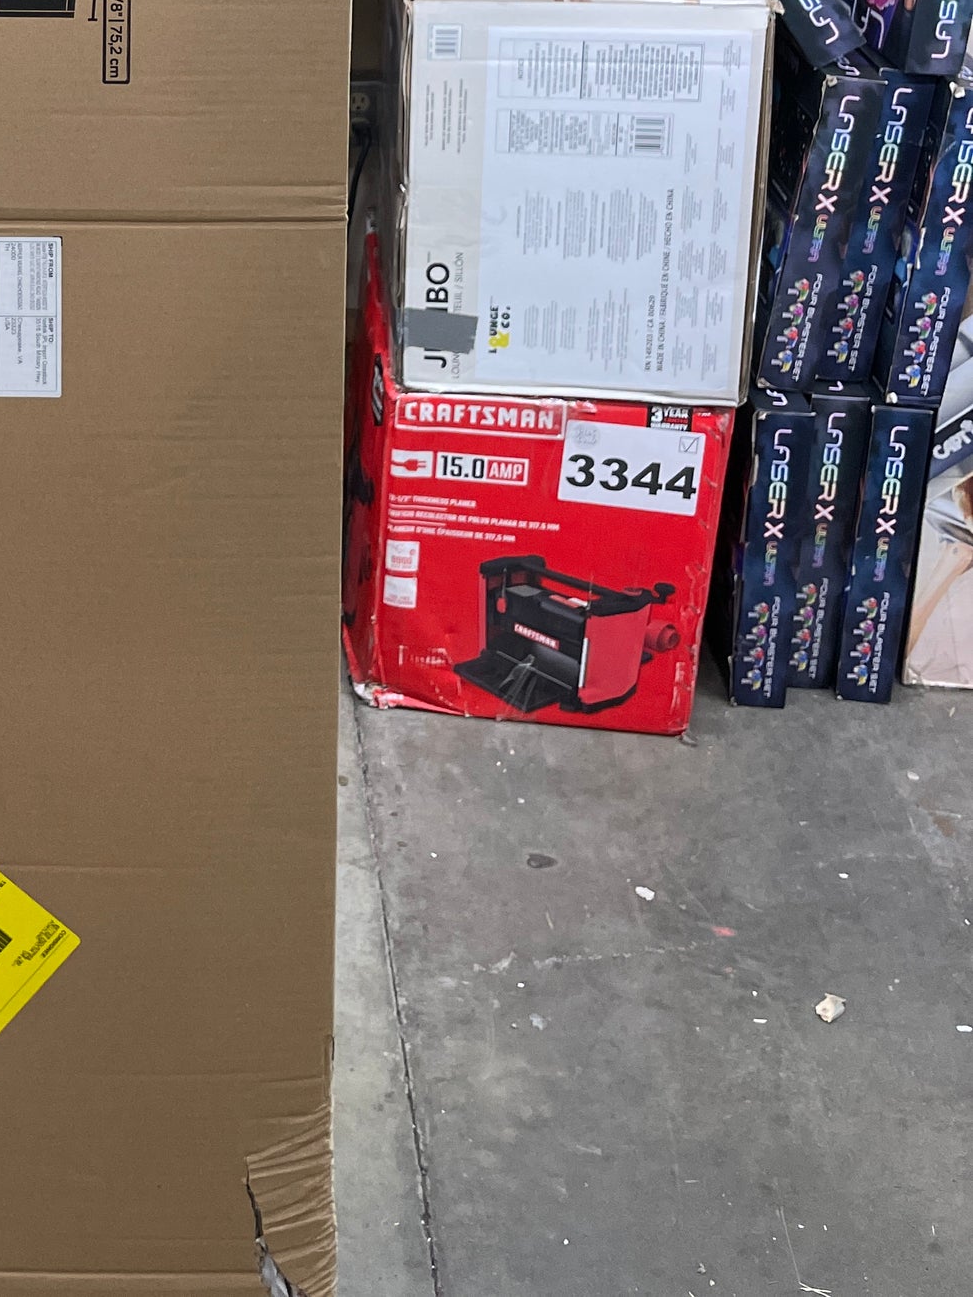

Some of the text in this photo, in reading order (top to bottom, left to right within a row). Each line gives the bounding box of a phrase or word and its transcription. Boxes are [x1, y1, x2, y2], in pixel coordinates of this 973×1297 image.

[107, 25, 123, 56] 75,2
[109, 58, 119, 79] cm
[815, 193, 838, 213] X
[869, 185, 892, 205] X
[424, 263, 449, 368] JBO
[404, 402, 554, 430] CRAFTSMAN
[650, 406, 689, 422] 3 YEAR
[441, 455, 523, 480] 15.0 AMP
[565, 454, 697, 500] 3344
[763, 521, 785, 539] X
[514, 623, 558, 649] CRAFTSMAN
